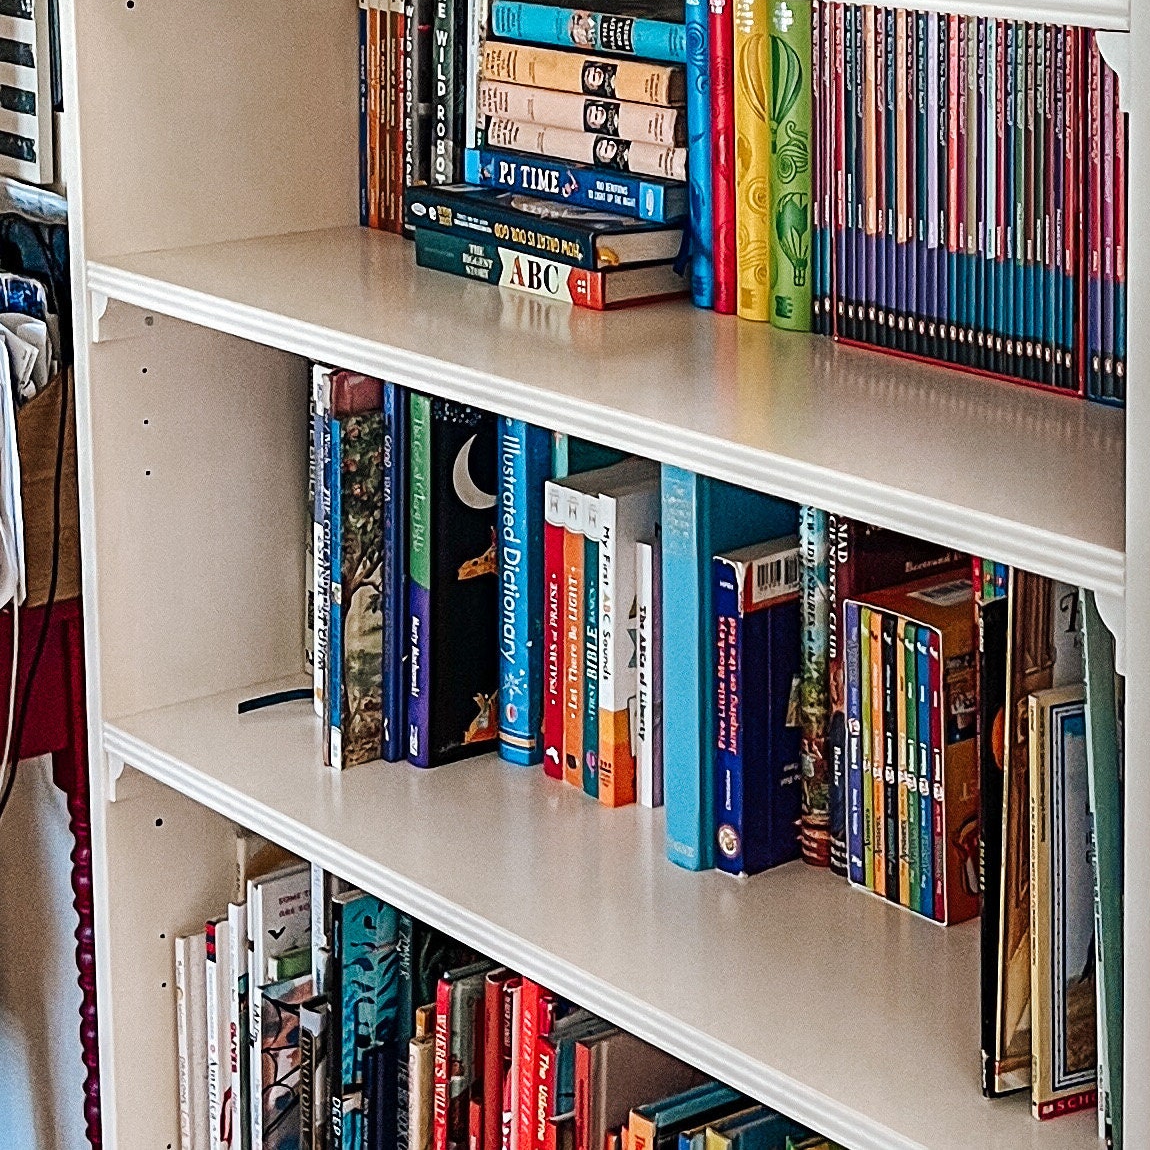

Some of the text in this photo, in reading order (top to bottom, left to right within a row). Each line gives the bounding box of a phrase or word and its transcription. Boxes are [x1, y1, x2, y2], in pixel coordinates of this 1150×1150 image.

[405, 5, 414, 52] WILD
[405, 57, 413, 114] ROBOT
[436, 29, 448, 97] WILD
[435, 104, 447, 185] ROBOT
[499, 161, 560, 193] PJ TIME
[493, 222, 510, 240] GOD
[510, 226, 527, 245] OUR
[527, 231, 535, 247] IS
[535, 233, 560, 253] GREAT
[561, 241, 580, 260] HOW
[509, 254, 560, 295] ABC
[500, 434, 521, 665] Illustrated Dictionary
[837, 523, 848, 564] MAD
[410, 615, 420, 645] Marty
[599, 525, 611, 681] My First ABC Sounds
[549, 581, 558, 695] PSALMS PRAISE
[568, 577, 578, 710] Let There LIGHT
[586, 625, 598, 681] BIBLE
[638, 605, 647, 742] The ABCs of Liberty
[717, 615, 727, 750] Five Little Monkeys
[728, 616, 738, 756] Jumping on the Bed
[209, 1057, 220, 1121] America
[301, 1035, 312, 1134] DINOTOPIA
[434, 1013, 447, 1125] WHERE'S WILL?
[538, 1053, 549, 1142] The Usborne
[331, 1096, 342, 1136] DEEP
